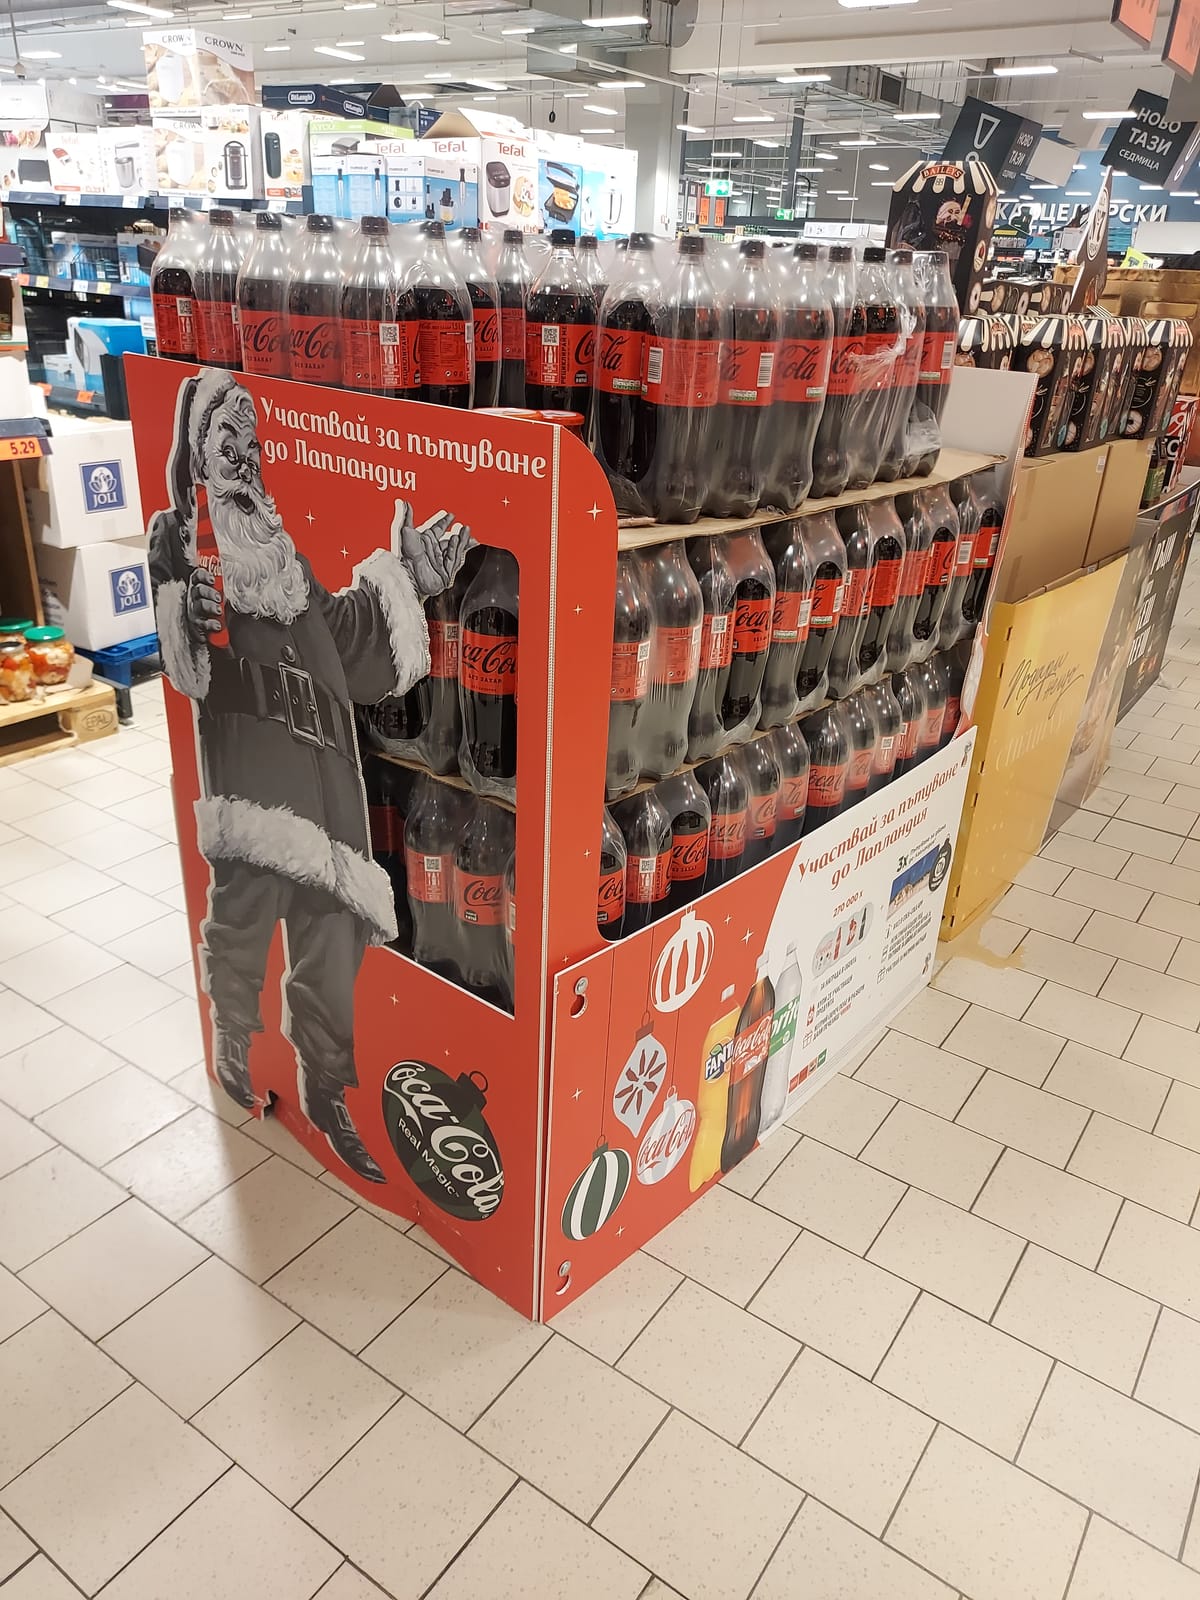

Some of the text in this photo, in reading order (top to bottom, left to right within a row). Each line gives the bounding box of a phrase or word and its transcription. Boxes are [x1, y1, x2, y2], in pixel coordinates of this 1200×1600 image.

[204, 36, 243, 52] CROWN
[376, 142, 407, 154] Tefal
[432, 140, 468, 153] Tefal
[497, 141, 526, 158] Tefal
[1128, 127, 1173, 156] ТАЗИ
[923, 164, 962, 179] BAILEYS
[1119, 149, 1160, 171] СЕДМИЦА
[10, 439, 36, 456] 5.29
[260, 397, 547, 479] Участвай за пътуване
[264, 438, 417, 492] до Лапландия
[93, 491, 118, 508] JOLI
[120, 594, 142, 611] JOLI
[798, 762, 959, 882] Участвай за пътуване
[831, 807, 929, 890] до Лапландия
[833, 902, 845, 918] 270
[846, 893, 859, 908] 000
[705, 1041, 735, 1080] FANT
[383, 1061, 505, 1214] Coca-Cola
[398, 1118, 422, 1152] Real
